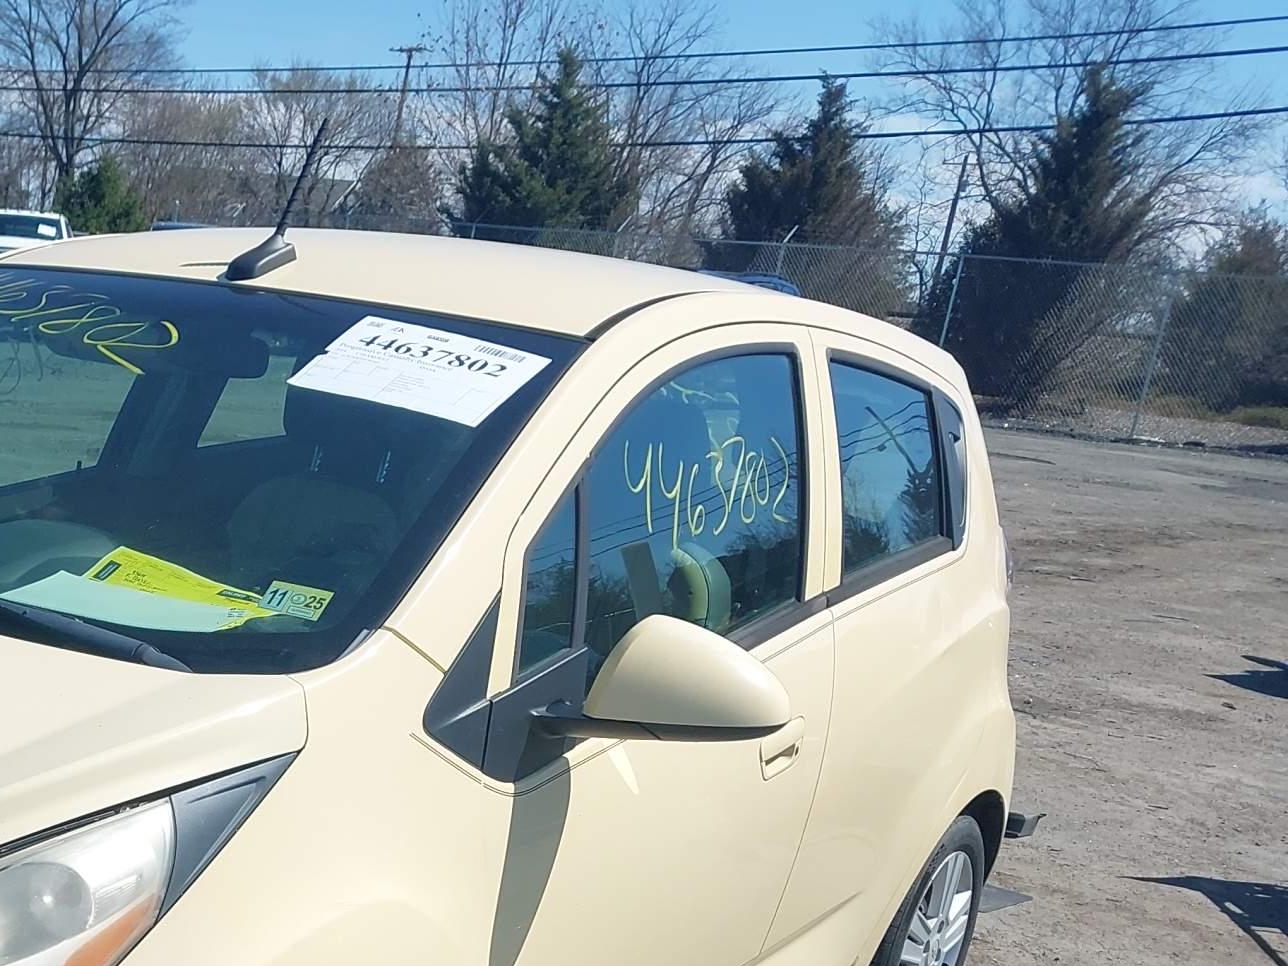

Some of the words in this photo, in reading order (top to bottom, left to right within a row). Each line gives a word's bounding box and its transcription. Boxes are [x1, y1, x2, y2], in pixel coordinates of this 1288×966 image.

[359, 334, 508, 377] 44637802
[624, 436, 790, 551] 44637802
[267, 588, 289, 607] 11
[304, 596, 327, 610] 25
